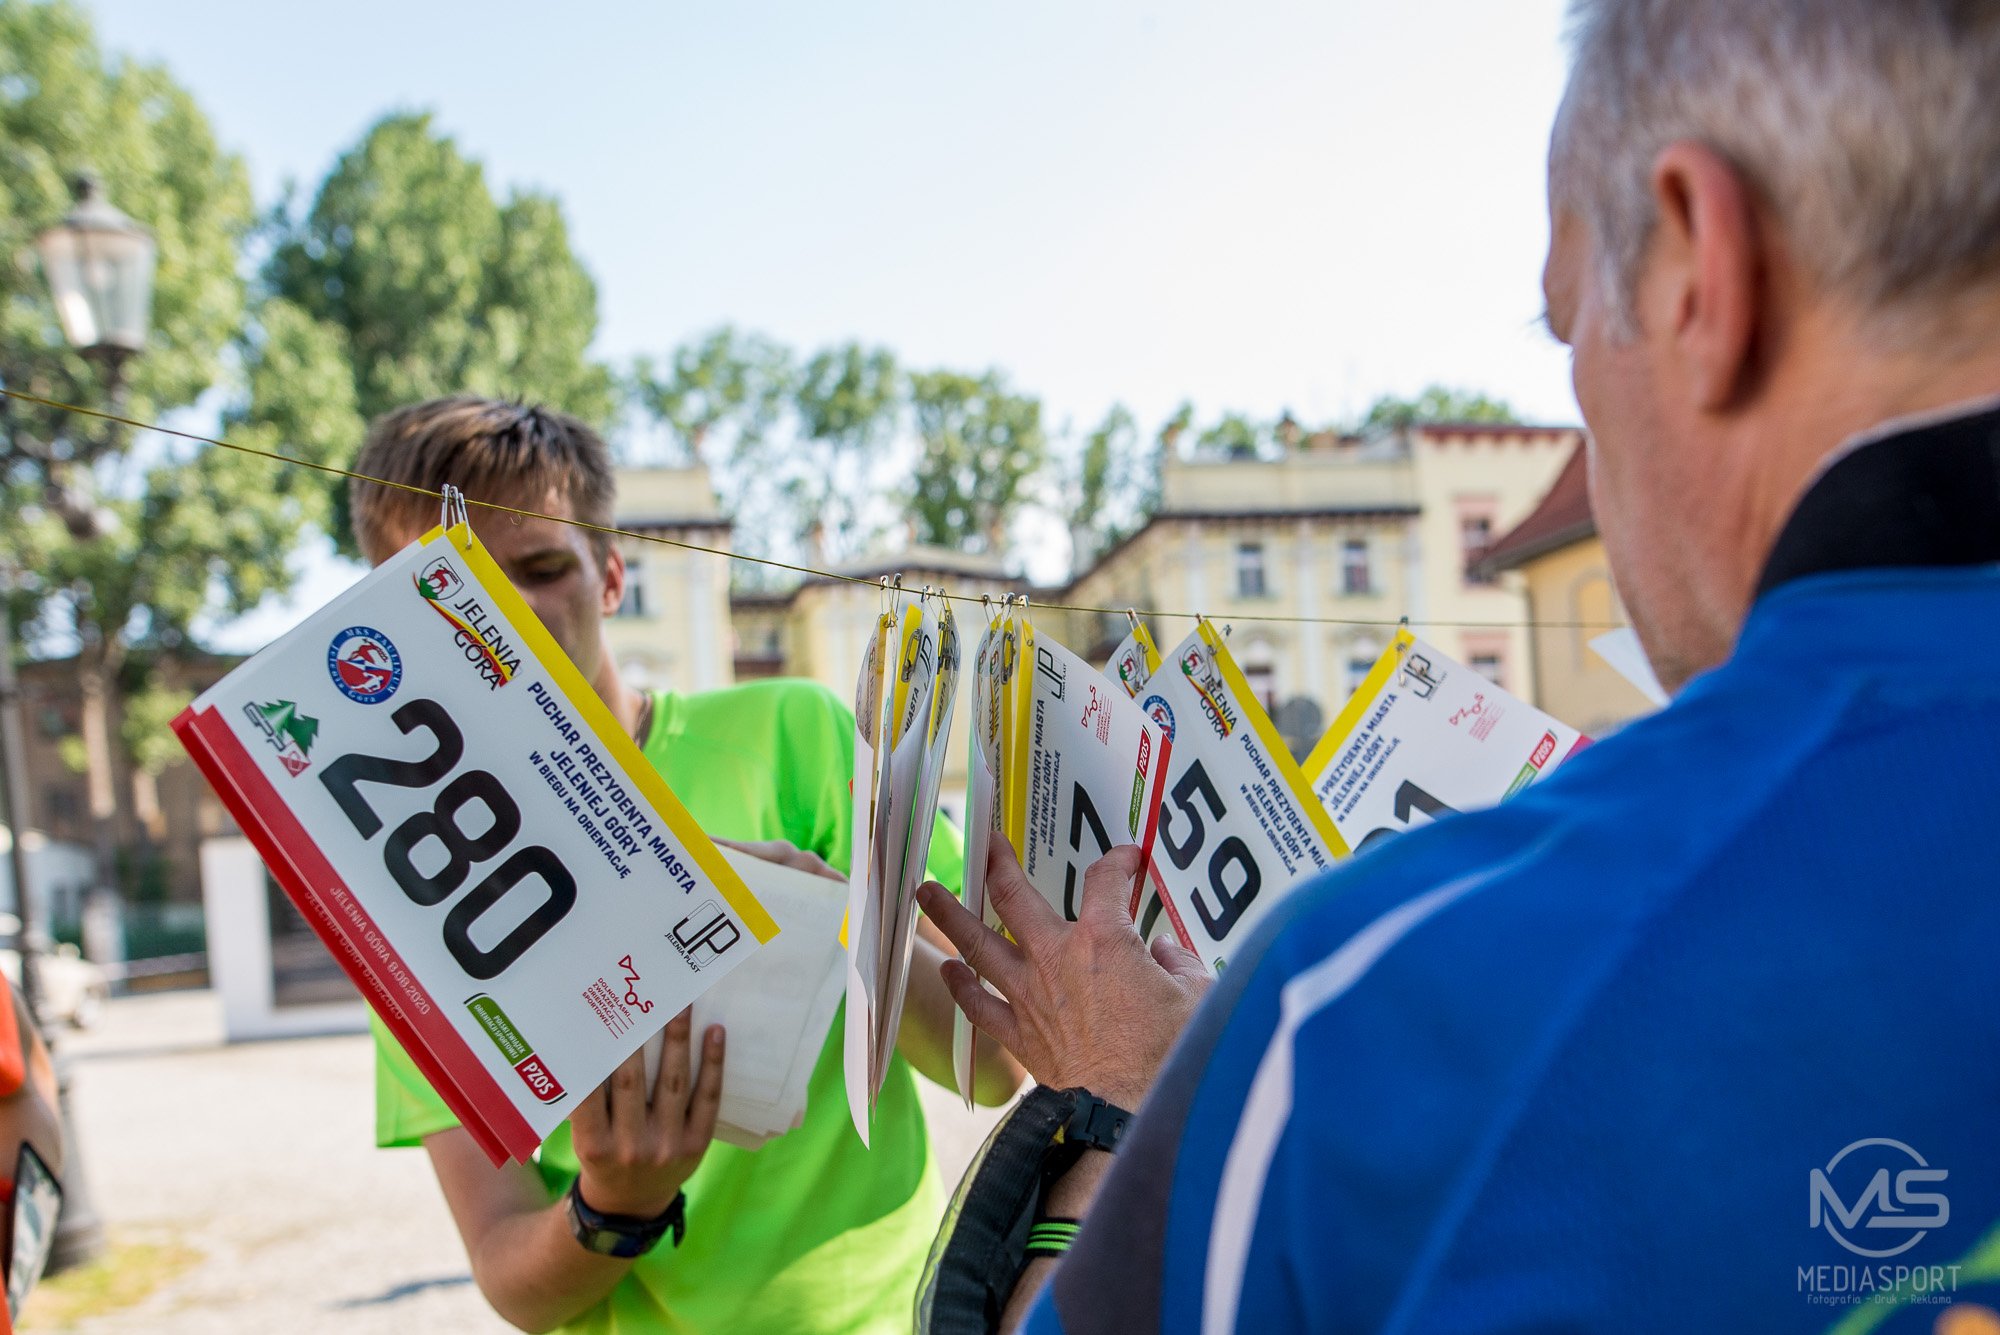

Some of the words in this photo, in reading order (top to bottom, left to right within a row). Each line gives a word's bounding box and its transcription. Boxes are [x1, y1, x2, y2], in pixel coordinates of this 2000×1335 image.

[454, 629, 502, 691] GÓRA
[455, 598, 522, 676] JELENIA
[1035, 699, 1045, 748] MIASTA
[1200, 696, 1227, 741] GÓRA
[1321, 732, 1370, 796] PREZYDENTA
[1366, 693, 1398, 733] MIASTA
[1044, 749, 1052, 783] GÓRY
[1139, 739, 1149, 772] PZOS
[1330, 764, 1366, 811] JELENIEJ
[1362, 734, 1385, 764] GÓRY
[527, 681, 581, 746] PUCHAR
[575, 743, 653, 839] PREZYDENTA
[648, 835, 697, 895] MIASTA
[529, 751, 543, 766] W
[539, 764, 568, 798] BIEGU
[564, 797, 577, 816] NA
[577, 813, 632, 879] ORIENTACJĘ
[550, 751, 609, 818] JELENIEJ
[605, 817, 642, 857] GÓRY
[1031, 750, 1042, 827] PREZYDENTA
[1039, 784, 1050, 844] JELENIEJ
[1052, 808, 1057, 820] NA
[1240, 733, 1271, 780] PUCHAR
[1267, 778, 1312, 848] PREZYDENTA
[1308, 842, 1330, 874] MIAS
[1240, 784, 1247, 794] W
[1244, 793, 1262, 819] BIEGU
[1258, 817, 1269, 831] NA
[318, 698, 578, 980] 280
[1028, 825, 1037, 877] PUCHAR
[1157, 758, 1261, 942] 59
[1251, 783, 1284, 832] JELENIEJ
[1281, 830, 1305, 861] GÓRY
[330, 888, 368, 933] JELENIA
[364, 930, 390, 964] GÓRA
[387, 961, 432, 1016] 8.08.2020
[664, 933, 685, 956] JELENIA
[684, 955, 701, 973] PLAST
[582, 992, 612, 1027] SPORTOWEJ
[587, 987, 615, 1020] ORIENTACJI
[522, 1062, 554, 1094] PZOS
